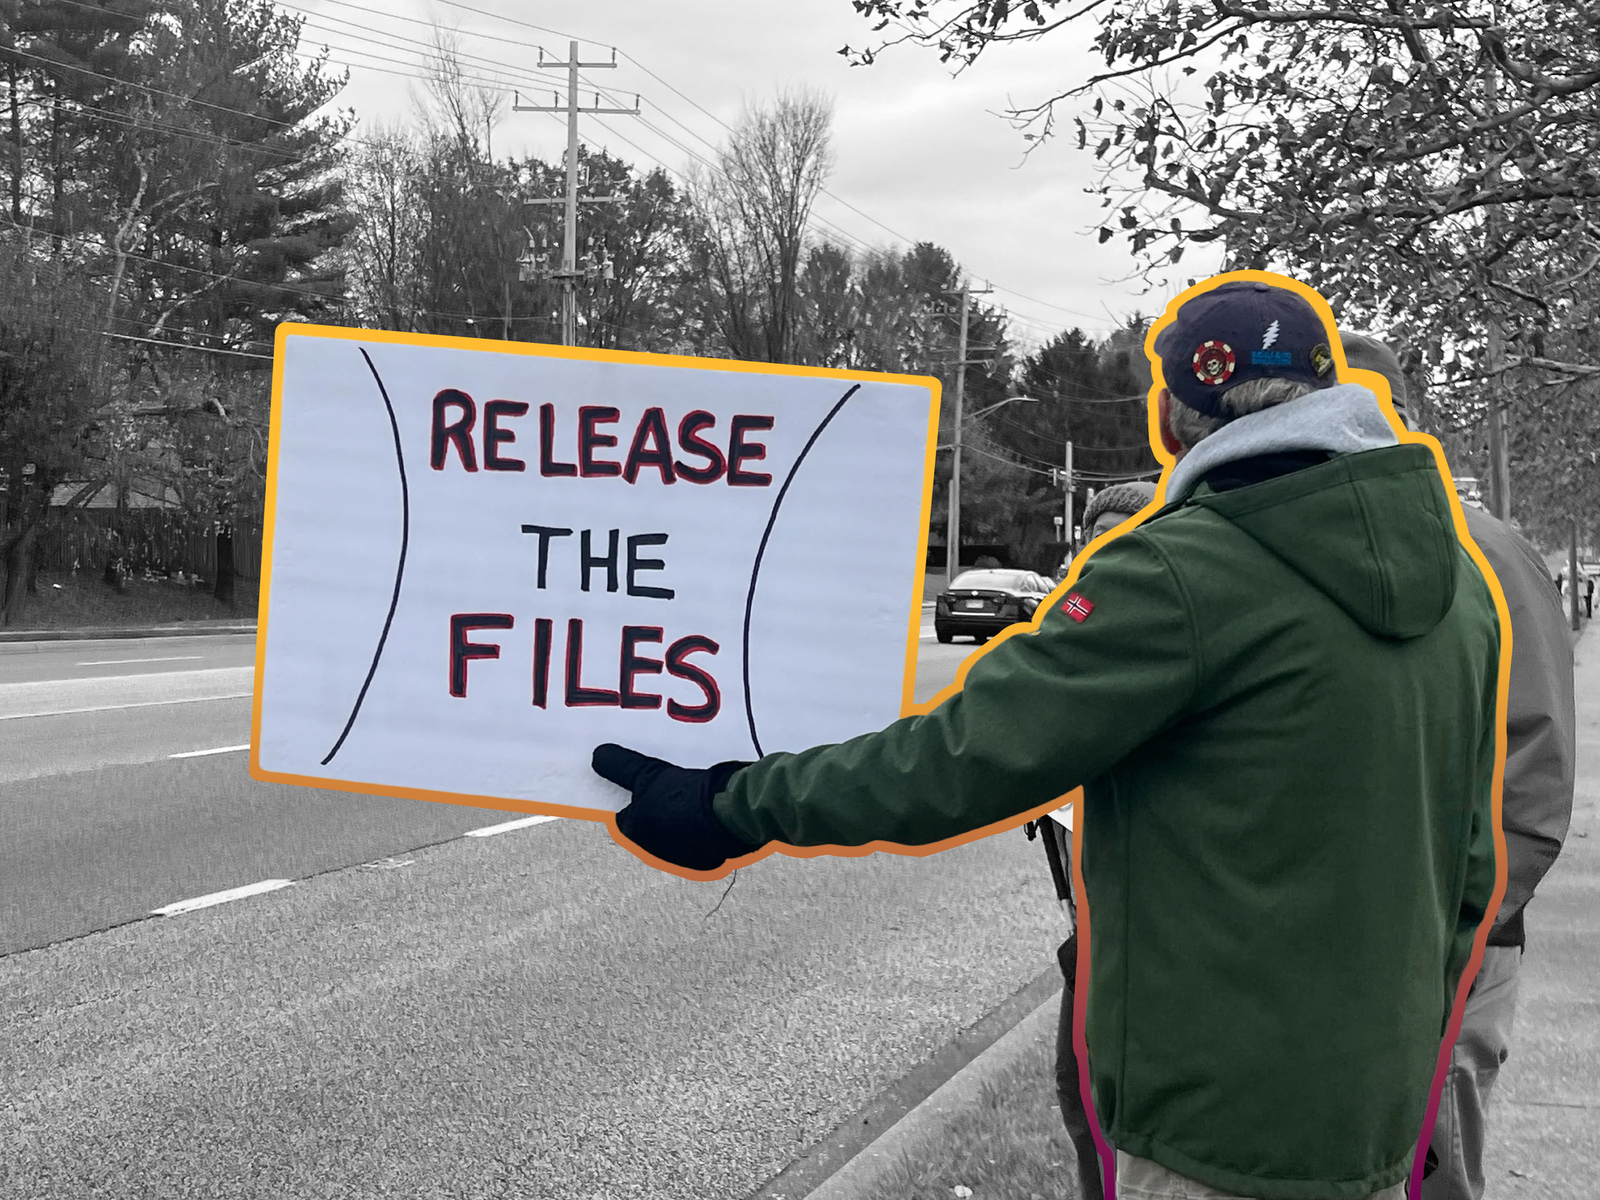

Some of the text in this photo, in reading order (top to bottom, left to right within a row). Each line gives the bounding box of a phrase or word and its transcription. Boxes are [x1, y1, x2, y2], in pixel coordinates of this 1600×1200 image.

[431, 389, 774, 486] RELEASE
[521, 525, 675, 600] THE
[450, 613, 720, 723] FILES
